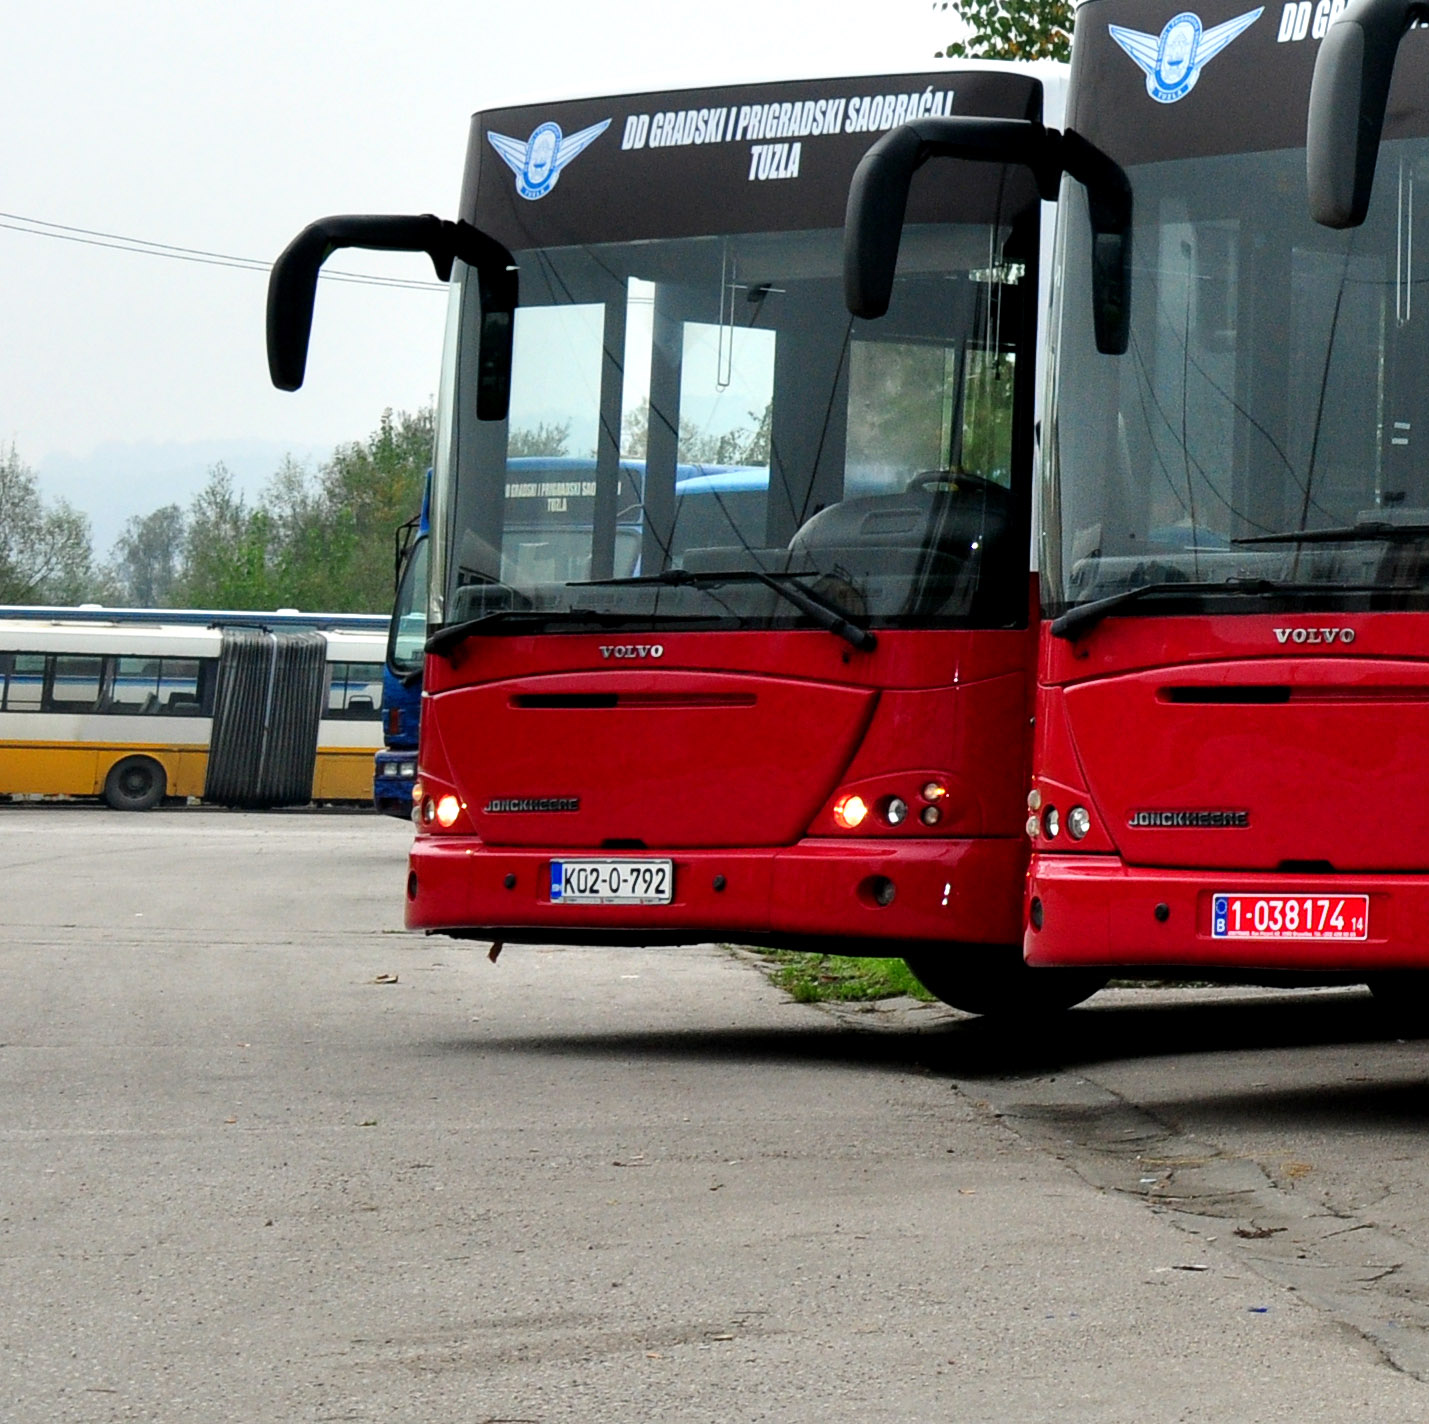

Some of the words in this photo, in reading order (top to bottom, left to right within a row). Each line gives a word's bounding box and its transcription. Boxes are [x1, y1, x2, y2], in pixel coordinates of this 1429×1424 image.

[1277, 1, 1312, 43] DD
[621, 115, 649, 150] DD
[649, 107, 727, 148] GRADSKI
[726, 107, 739, 141] I
[739, 98, 847, 140] PRIGRADSKI
[749, 142, 801, 181] TUZLA
[1272, 627, 1355, 644] VOLVO
[598, 644, 664, 659] VOLVO
[1128, 812, 1248, 826] JONCKHEERE
[1216, 918, 1226, 933] B
[1351, 916, 1364, 931] 14
